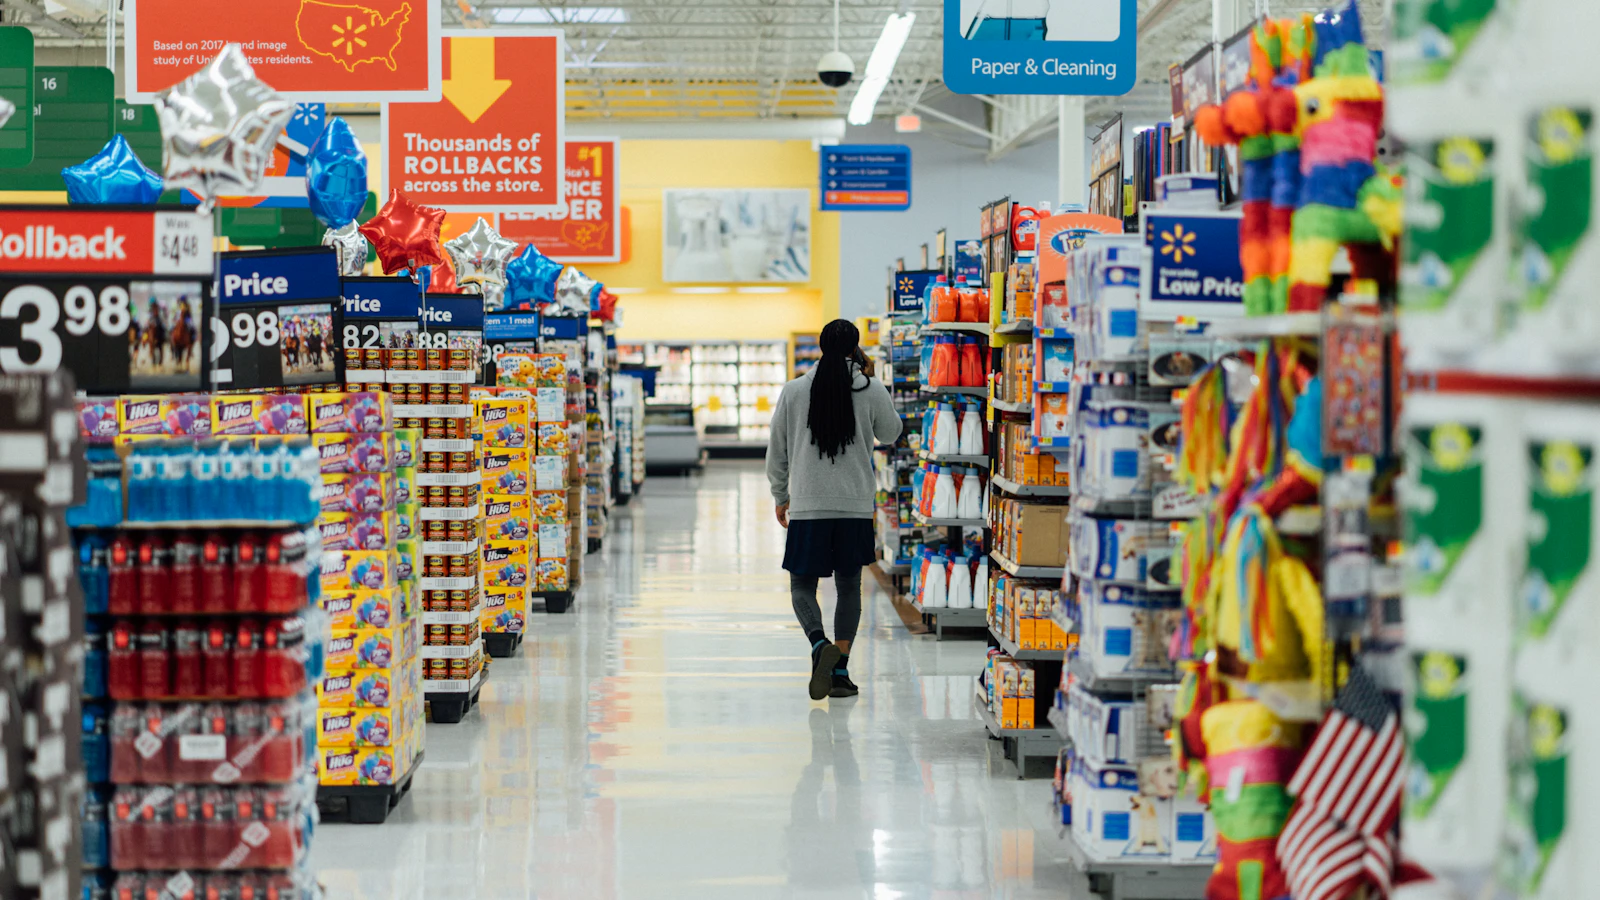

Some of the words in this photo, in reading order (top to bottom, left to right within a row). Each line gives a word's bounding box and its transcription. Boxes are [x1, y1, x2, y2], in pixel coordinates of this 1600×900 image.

[153, 41, 183, 50] Based
[185, 42, 198, 50] on
[201, 40, 223, 50] 2017
[257, 40, 287, 52] image
[153, 55, 180, 67] study
[183, 55, 194, 65] of
[265, 54, 313, 64] residents.
[971, 57, 1021, 79] Paper
[1024, 58, 1039, 76] &
[1042, 58, 1117, 80] Cleaning
[42, 78, 57, 89] 16
[121, 108, 135, 120] 18
[403, 133, 512, 152] Thousands
[517, 132, 541, 152] of
[404, 156, 543, 175] ROLLBACKS
[578, 145, 603, 178] #1
[403, 180, 458, 192] across
[462, 176, 492, 192] the
[496, 178, 544, 192] store.
[564, 180, 602, 197] RICE
[0, 226, 126, 259] ollback
[224, 272, 289, 297] Price
[1159, 277, 1200, 296] Low
[900, 297, 917, 306] Low
[514, 316, 534, 324] meal
[343, 325, 380, 349] 82
[540, 326, 556, 336] ice
[418, 332, 448, 349] 88
[130, 403, 158, 420] HUG
[223, 404, 251, 420] HUG
[320, 404, 343, 419] HUG
[485, 409, 506, 421] HUG
[322, 445, 346, 458] HUG
[489, 504, 509, 516] HUG
[323, 524, 346, 537] HUG
[327, 599, 350, 613] HUG
[329, 639, 352, 653] HUG
[326, 677, 350, 692] HUG
[326, 717, 350, 731] HUG
[329, 755, 353, 769] HUG
